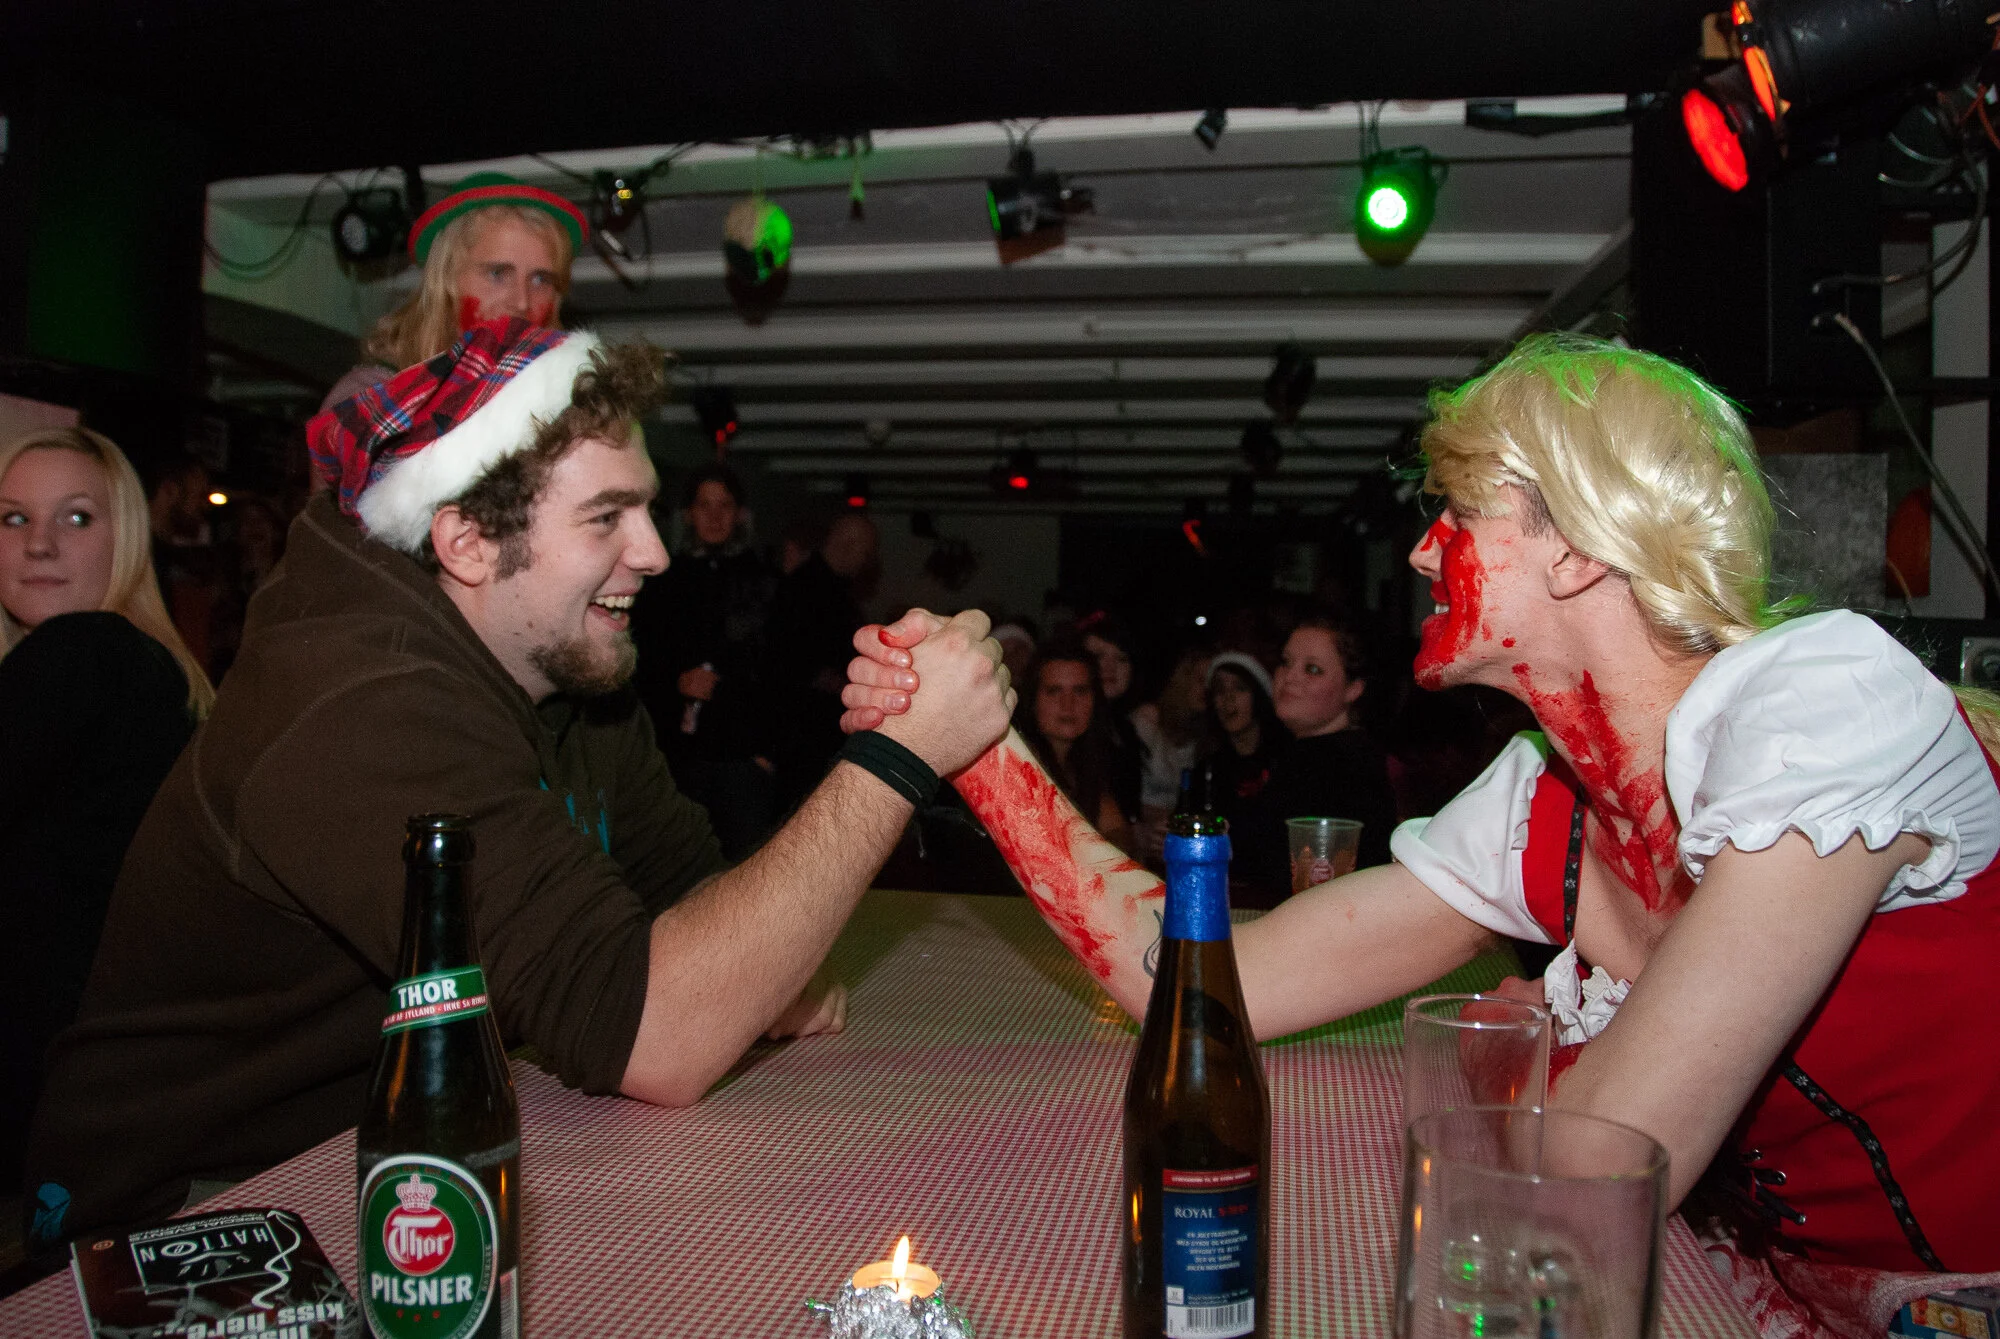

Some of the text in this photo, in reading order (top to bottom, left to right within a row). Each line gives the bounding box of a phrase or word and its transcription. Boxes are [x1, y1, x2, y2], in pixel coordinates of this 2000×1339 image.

[398, 978, 457, 1009] THOR
[405, 1005, 435, 1019] JYLLAND
[443, 1000, 461, 1012] IKKE
[1173, 1207, 1214, 1219] ROYAL
[388, 1216, 451, 1264] Thor
[371, 1272, 473, 1306] PILSNER
[277, 1302, 344, 1326] kiss
